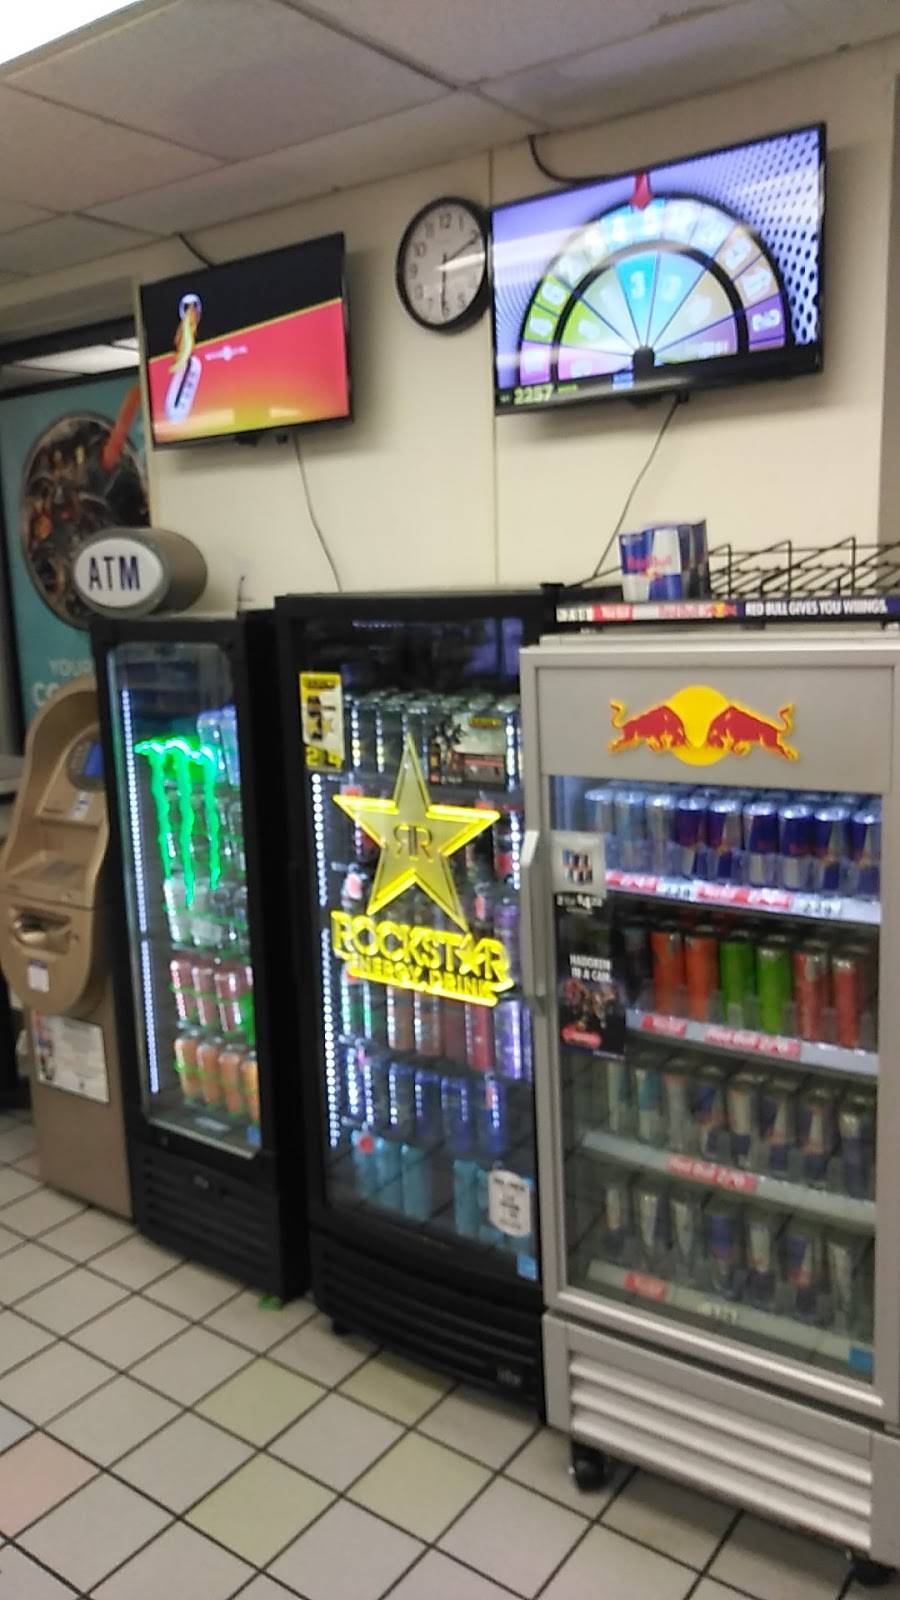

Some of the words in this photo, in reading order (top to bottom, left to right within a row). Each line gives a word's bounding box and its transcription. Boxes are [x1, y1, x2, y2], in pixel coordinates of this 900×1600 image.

[88, 555, 141, 591] ATM
[745, 600, 764, 617] RED
[765, 600, 788, 616] BULL
[788, 599, 818, 615] GIVES
[819, 599, 841, 615] YOU
[427, 968, 497, 1001] DRINK
